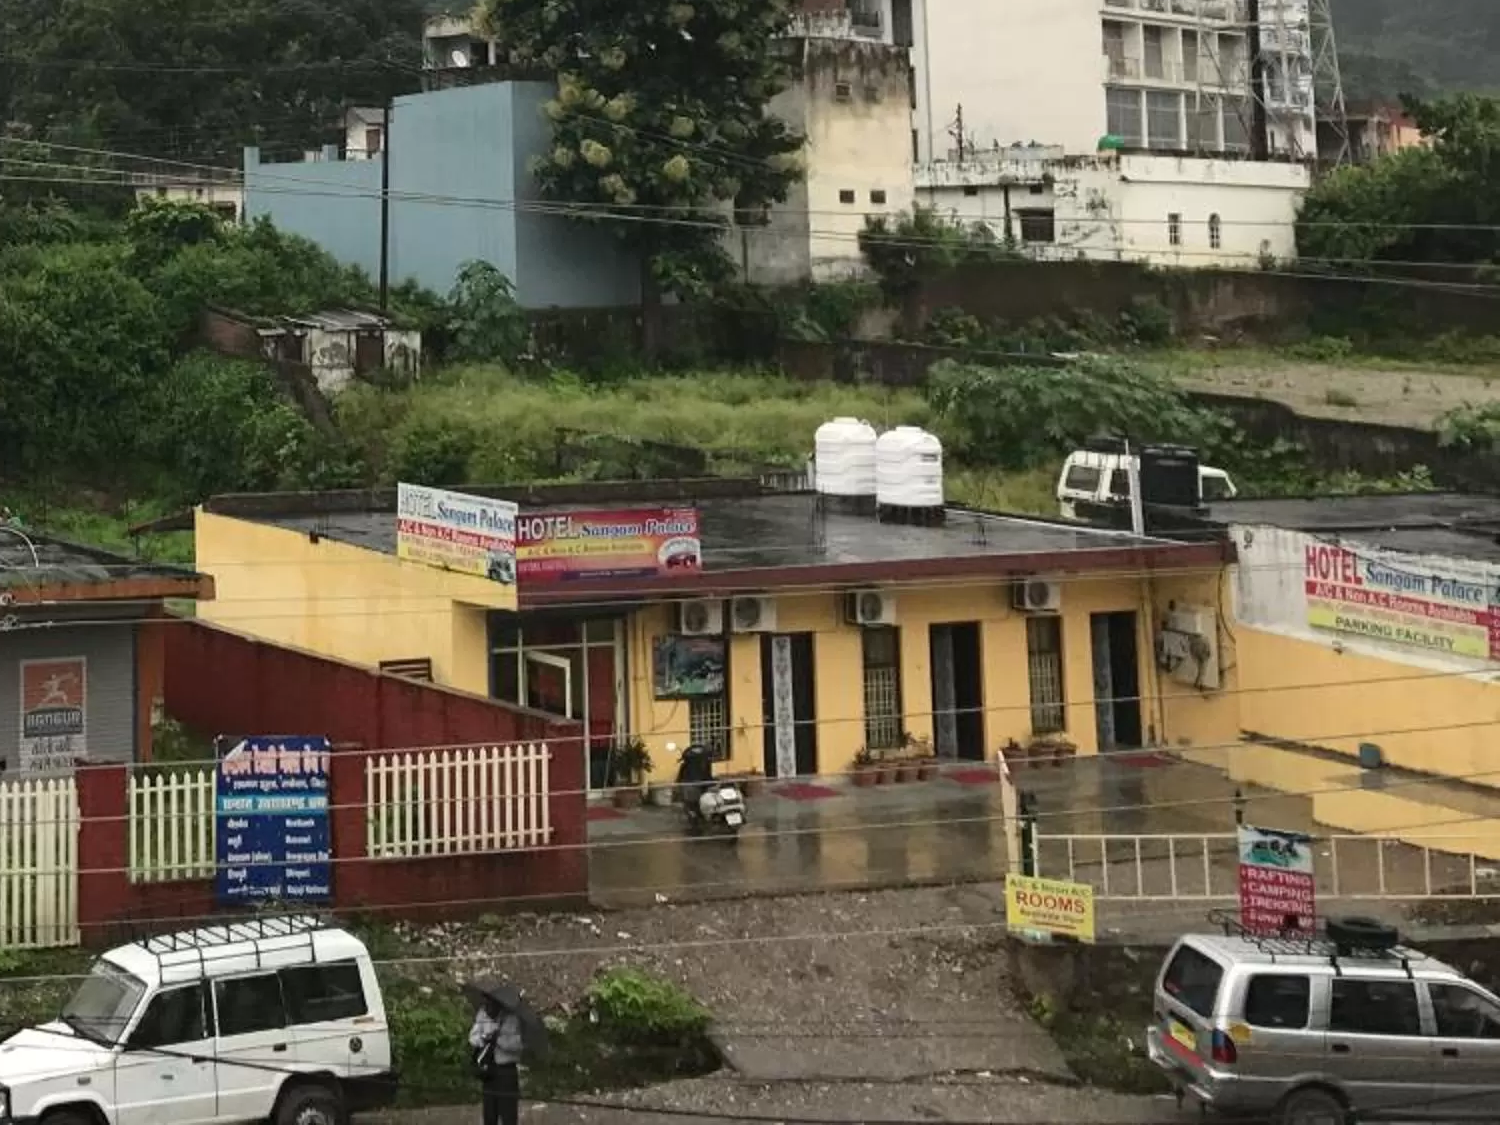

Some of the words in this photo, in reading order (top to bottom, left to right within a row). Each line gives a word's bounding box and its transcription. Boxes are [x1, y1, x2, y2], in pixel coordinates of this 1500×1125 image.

[518, 517, 578, 539] HOTEL
[1305, 545, 1363, 585] HOTEL
[1366, 562, 1425, 592] Sangam
[1431, 575, 1483, 601] Palace
[1335, 616, 1392, 636] PARKING
[1395, 627, 1455, 649] FACILITY
[1248, 867, 1312, 886] RAFTING
[1016, 890, 1085, 914] ROOMS
[1248, 882, 1312, 902] CAMPING
[1250, 895, 1313, 914] TREKKING
